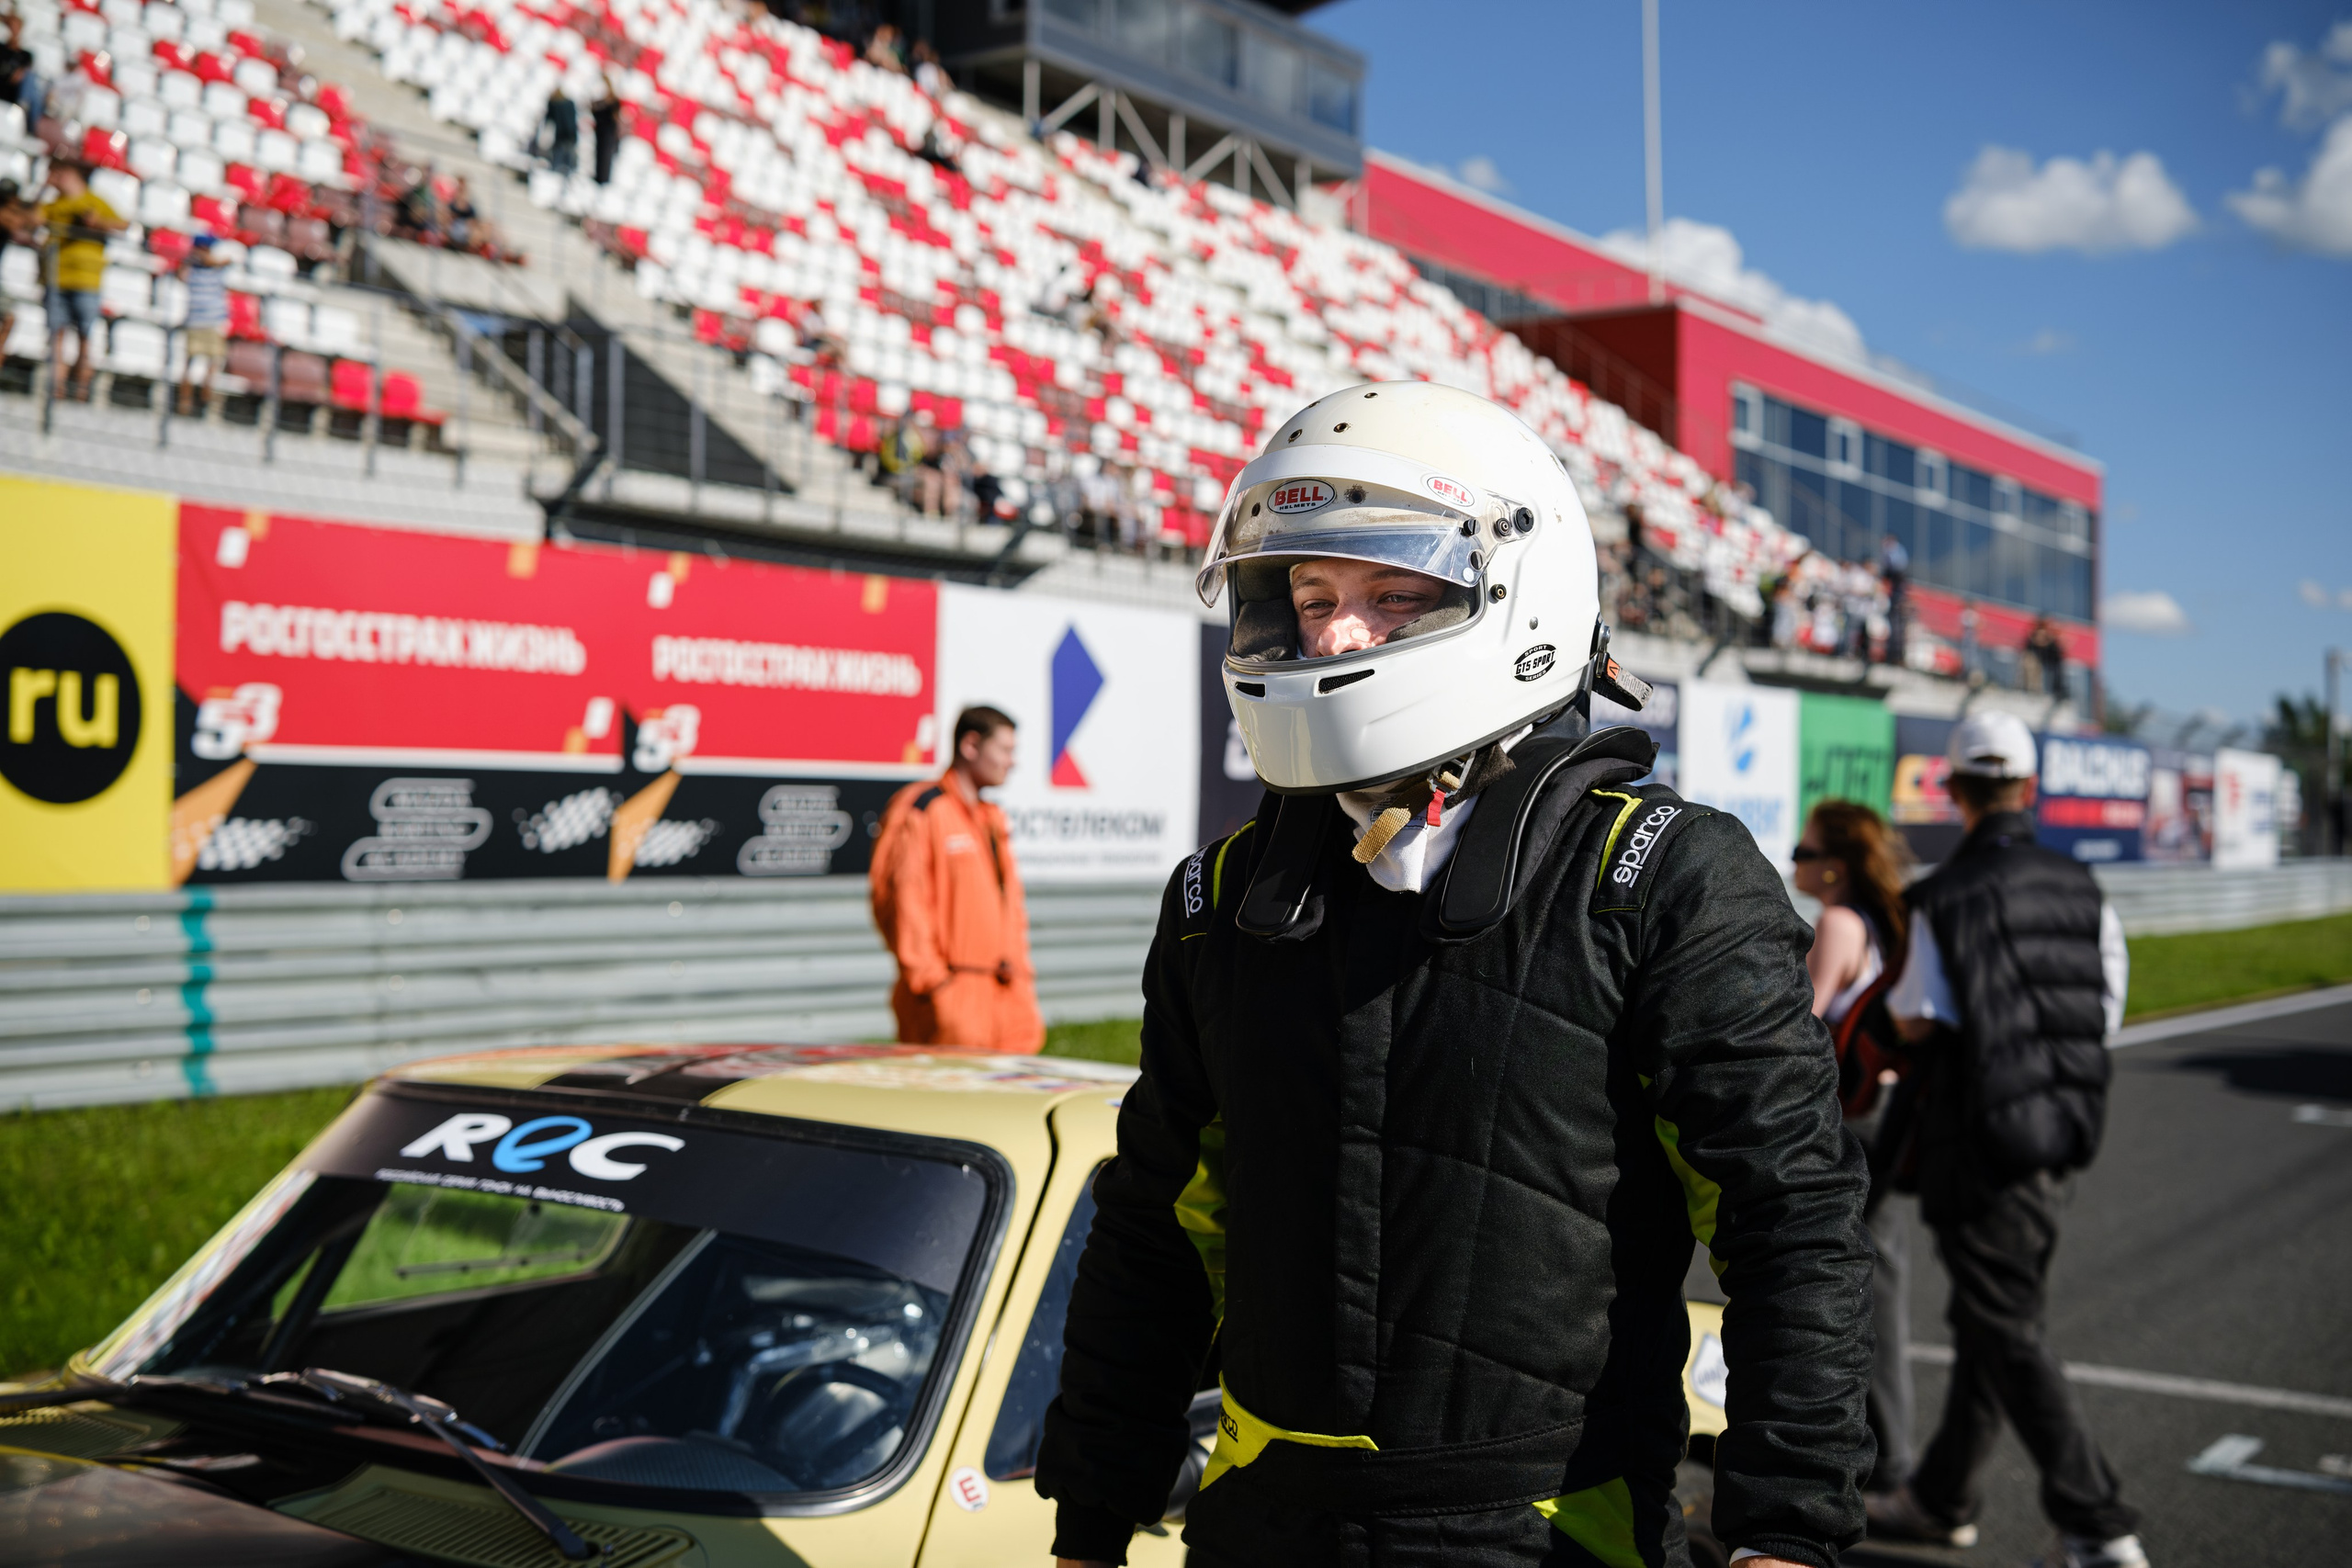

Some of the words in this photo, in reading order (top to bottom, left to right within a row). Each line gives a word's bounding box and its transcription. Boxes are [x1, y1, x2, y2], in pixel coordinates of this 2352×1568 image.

[1274, 486, 1324, 506] BELL
[1433, 479, 1468, 503] BELL
[1279, 502, 1317, 511] HELMETS
[1532, 650, 1555, 669] SPORT
[8, 666, 119, 750] ru
[1612, 806, 1676, 886] sparco
